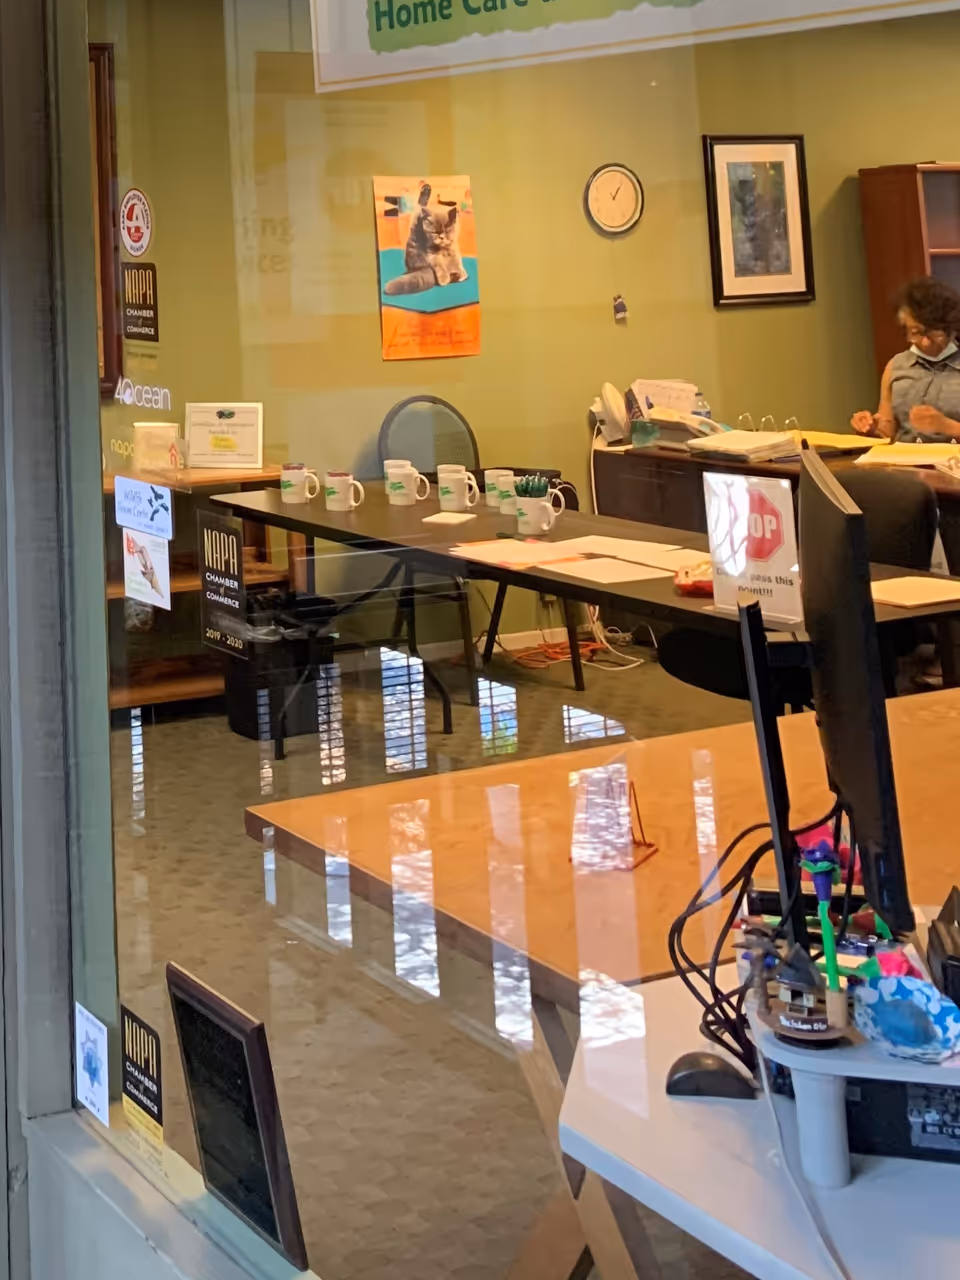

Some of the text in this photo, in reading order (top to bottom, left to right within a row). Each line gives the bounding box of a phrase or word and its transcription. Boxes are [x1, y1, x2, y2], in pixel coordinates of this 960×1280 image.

[124, 269, 154, 306] NAPA
[126, 307, 154, 318] CHAMBER
[126, 325, 155, 335] COMMERCE
[203, 527, 238, 576] NAPA
[205, 572, 239, 590] CHAMBER
[775, 575, 794, 587] this
[206, 591, 240, 609] COMMERCE
[205, 628, 221, 641] 2019
[226, 635, 243, 649] 2020
[124, 1014, 157, 1080] NAPA
[125, 1061, 158, 1095] CHAMBER
[126, 1081, 158, 1115] COMMERCE
